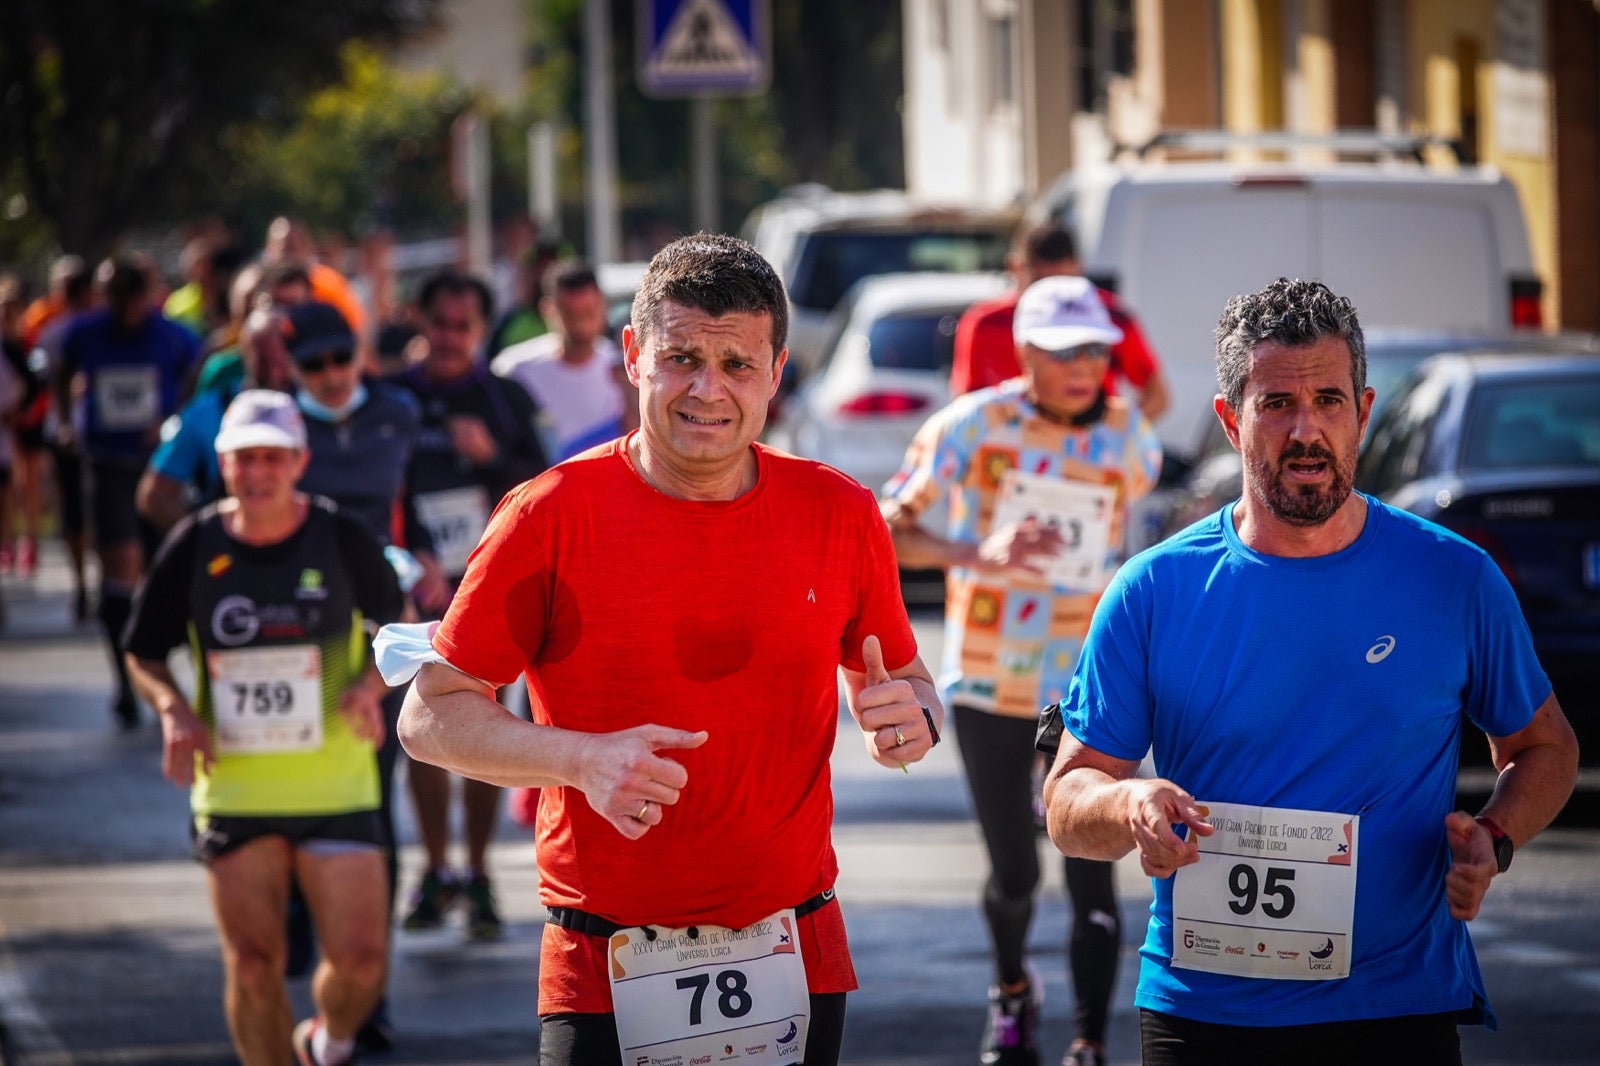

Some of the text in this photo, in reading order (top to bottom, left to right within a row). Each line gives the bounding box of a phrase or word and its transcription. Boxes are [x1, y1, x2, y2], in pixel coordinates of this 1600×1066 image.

[231, 681, 294, 716] 759
[1282, 824, 1308, 839] FONDO
[1310, 826, 1334, 841] 2022
[1228, 863, 1296, 919] 95
[722, 929, 748, 944] FONDO
[750, 921, 773, 938] 2022
[676, 946, 732, 962] UNIVERSO LORCA
[1309, 956, 1333, 970] Lorca
[676, 969, 753, 1026] 78
[776, 1044, 800, 1057] Lorca
